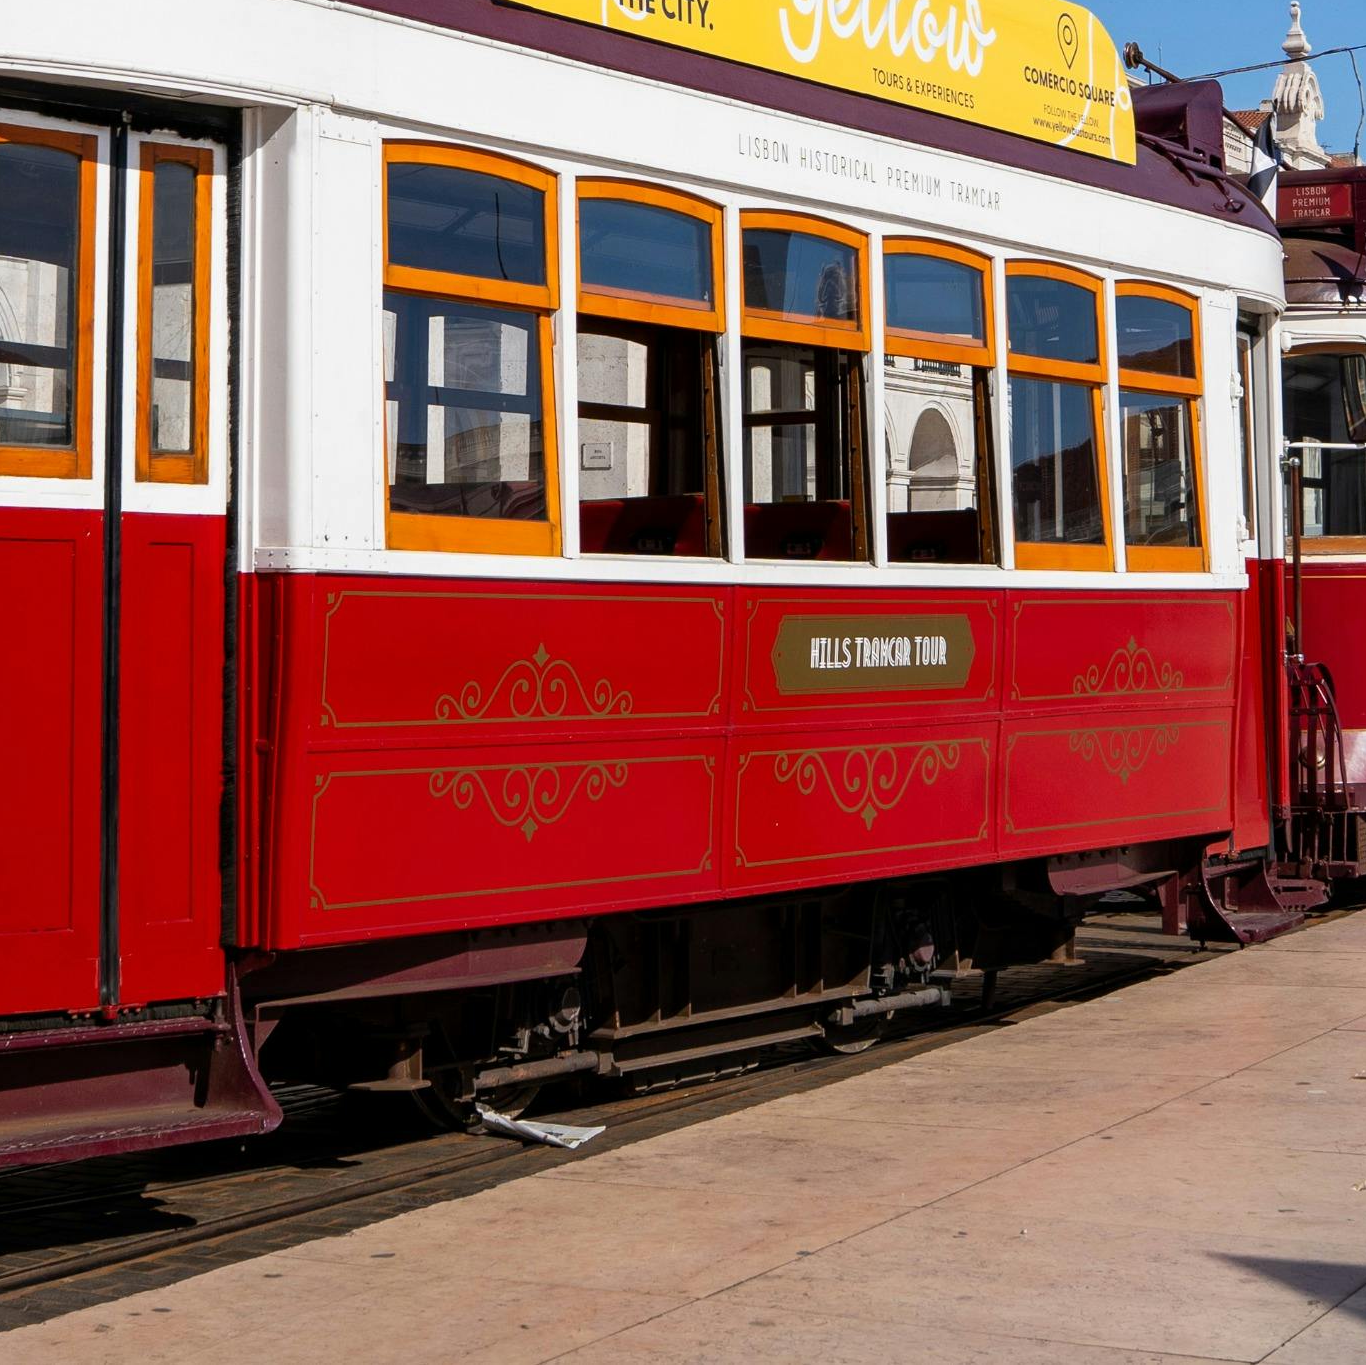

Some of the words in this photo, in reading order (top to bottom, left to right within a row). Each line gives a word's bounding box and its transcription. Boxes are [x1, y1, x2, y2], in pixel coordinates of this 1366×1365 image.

[872, 67, 904, 91] TOURS
[906, 76, 913, 92] &
[915, 79, 975, 109] EXPERIENCES
[1024, 65, 1077, 96] COMÉRCIO
[1079, 82, 1115, 107] SQUARE
[1043, 103, 1066, 119] FOLLOW
[738, 133, 789, 164] LISBON
[800, 146, 877, 184] HISTORICAL
[887, 166, 941, 198] PREMIUM
[950, 181, 1001, 212] TRAMCAR
[1292, 197, 1331, 207] PREMIUM
[1296, 186, 1327, 196] LISBON
[1293, 208, 1331, 218] TRAMCAR
[810, 637, 852, 669] HILLS
[854, 636, 911, 668] TRAMCAR
[914, 635, 947, 666] TOUR
